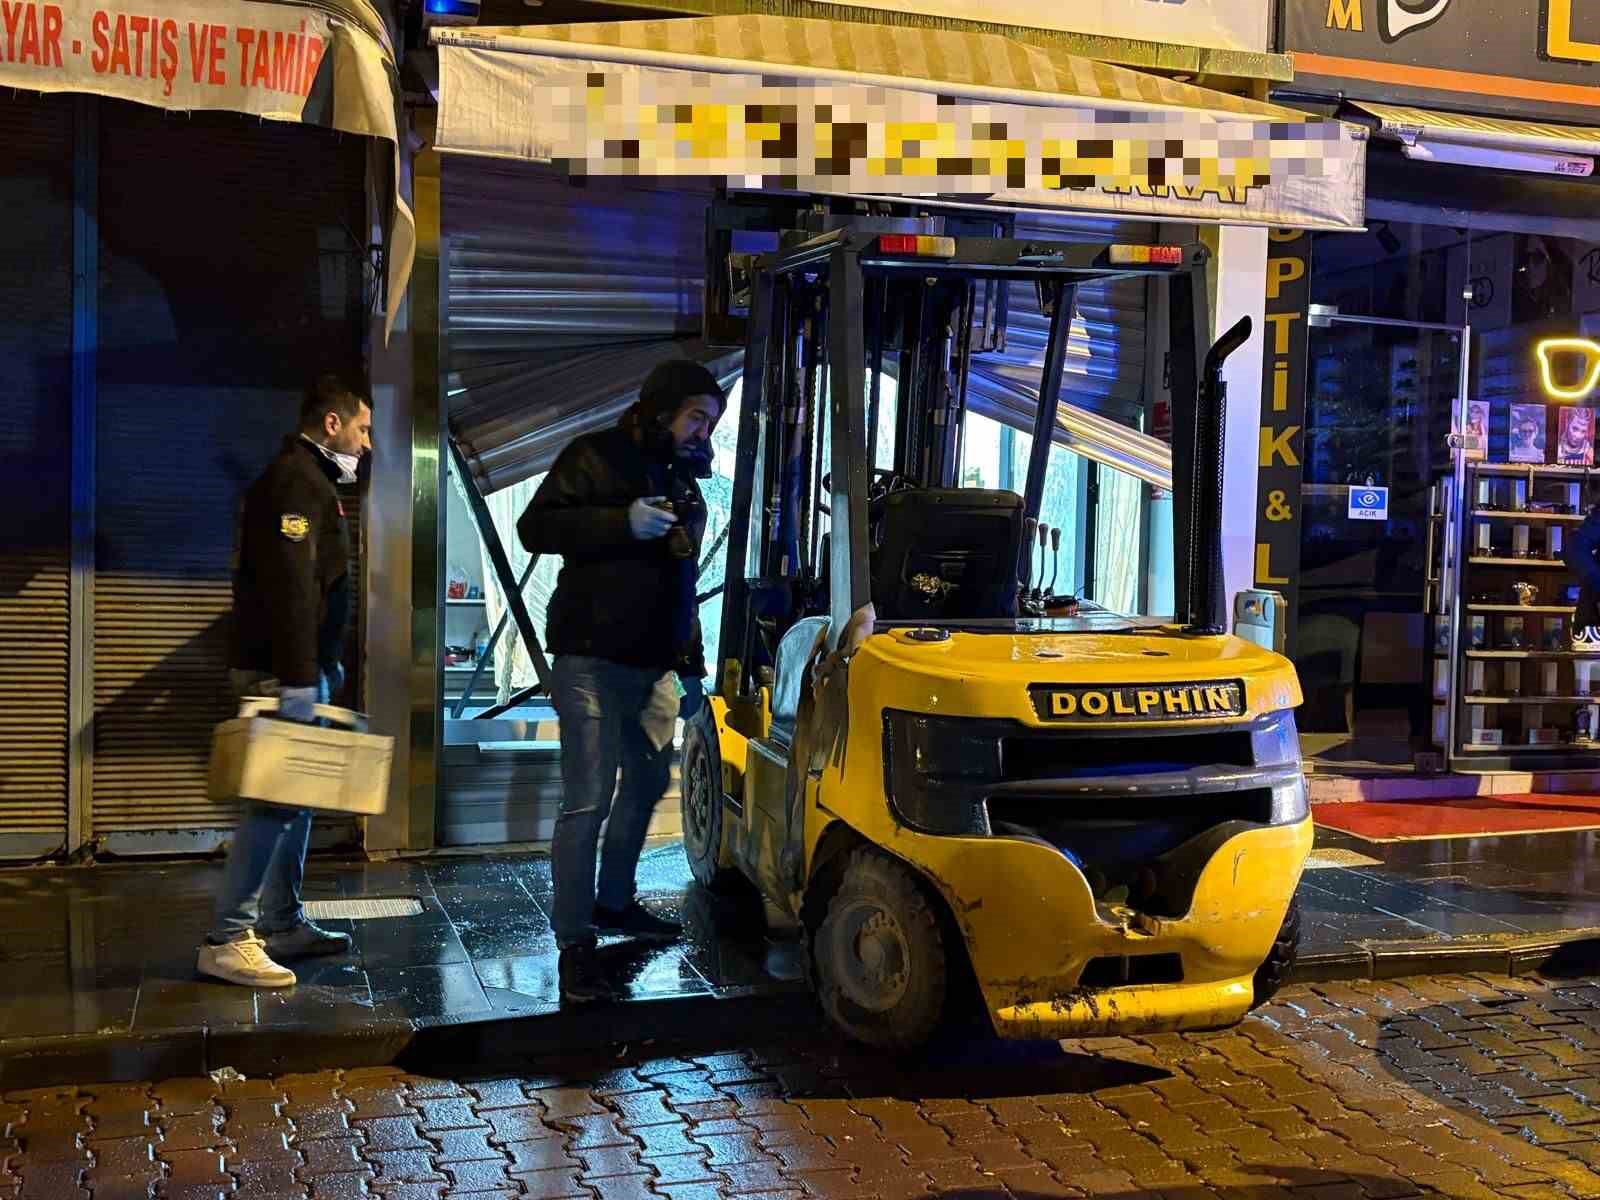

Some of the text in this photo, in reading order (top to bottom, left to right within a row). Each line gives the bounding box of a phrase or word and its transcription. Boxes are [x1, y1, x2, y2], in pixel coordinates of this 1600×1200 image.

[0, 0, 63, 67] YAR
[91, 10, 178, 96] SATIŞ
[188, 22, 226, 86] VE
[1265, 490, 1293, 522] &
[1050, 687, 1232, 716] DOLPHIN
